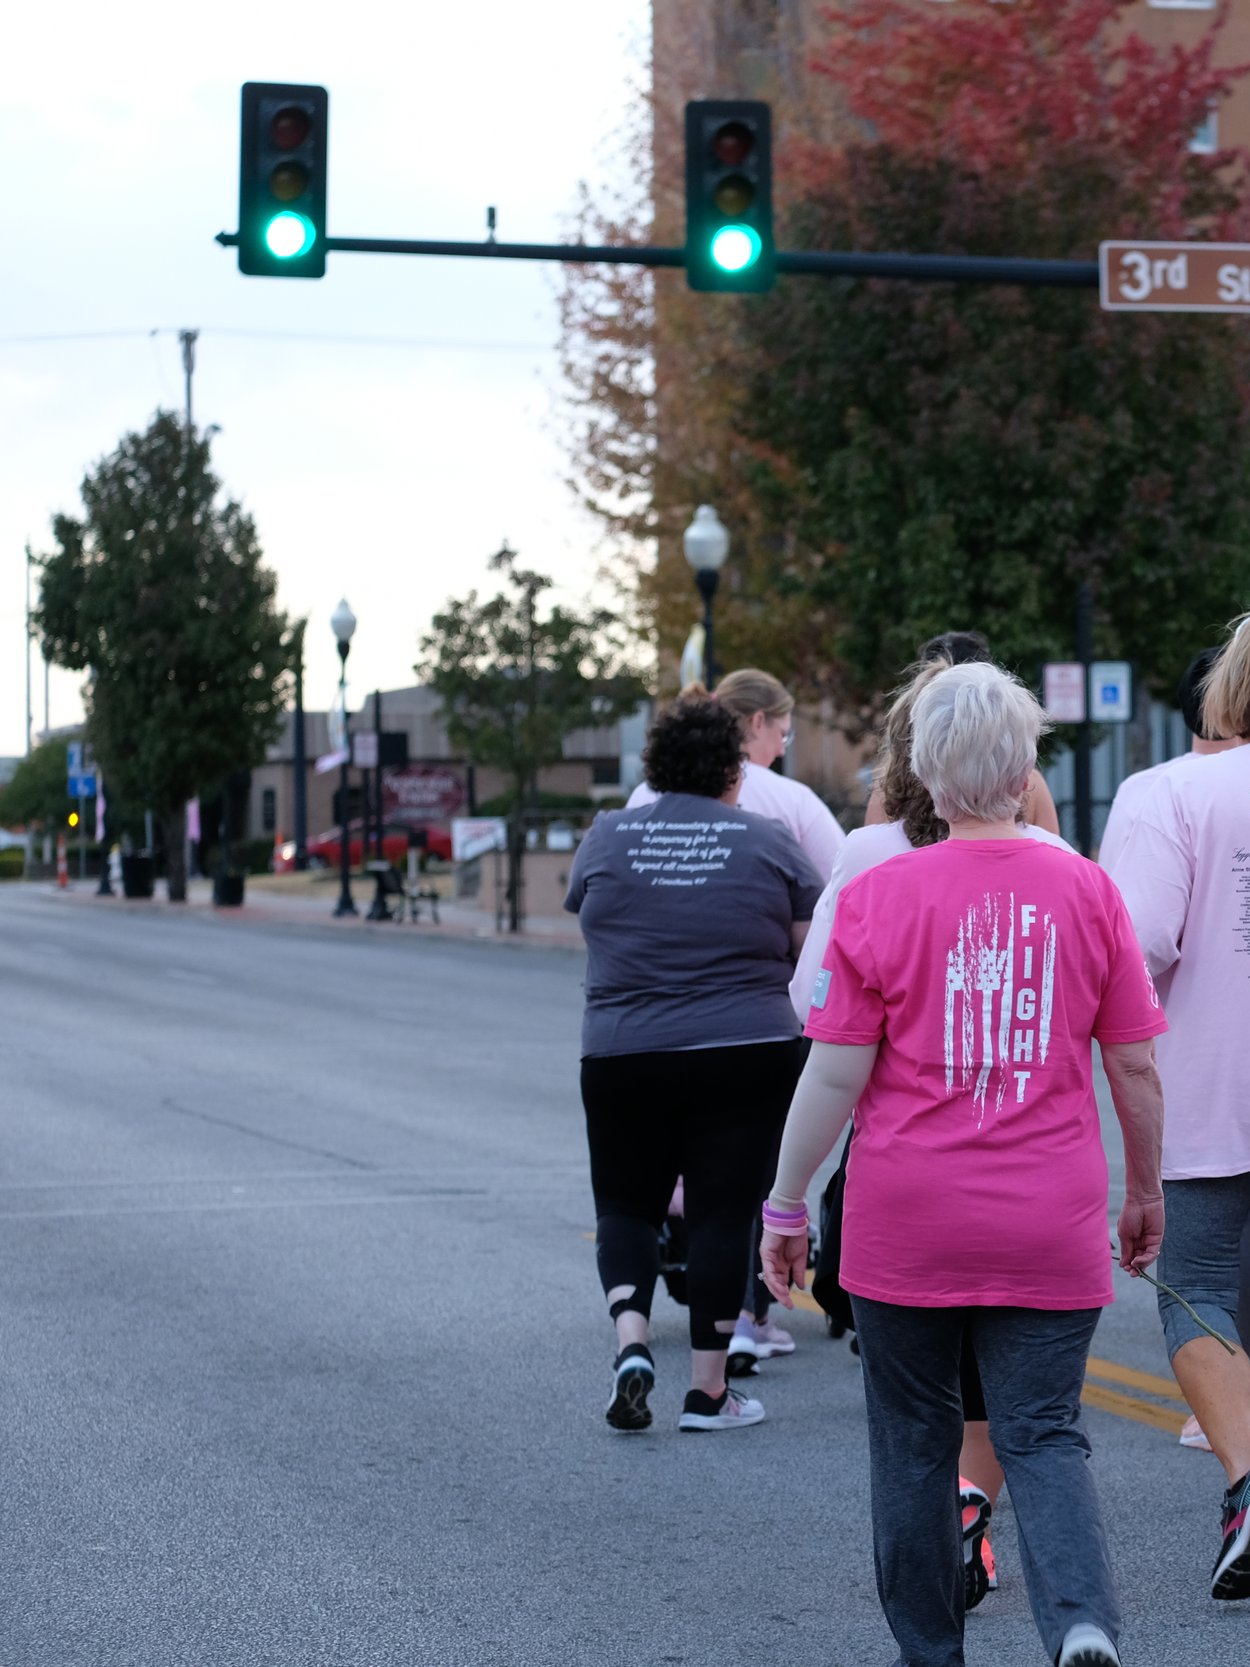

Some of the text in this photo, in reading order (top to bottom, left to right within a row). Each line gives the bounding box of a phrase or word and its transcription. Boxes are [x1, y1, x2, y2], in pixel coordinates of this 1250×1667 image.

[1118, 250, 1188, 301] 3rd
[692, 833, 707, 847] for
[707, 834, 718, 843] us
[698, 846, 709, 860] of
[707, 845, 732, 861] glory
[631, 859, 664, 874] beyond
[1013, 904, 1037, 1103] FIGHT
